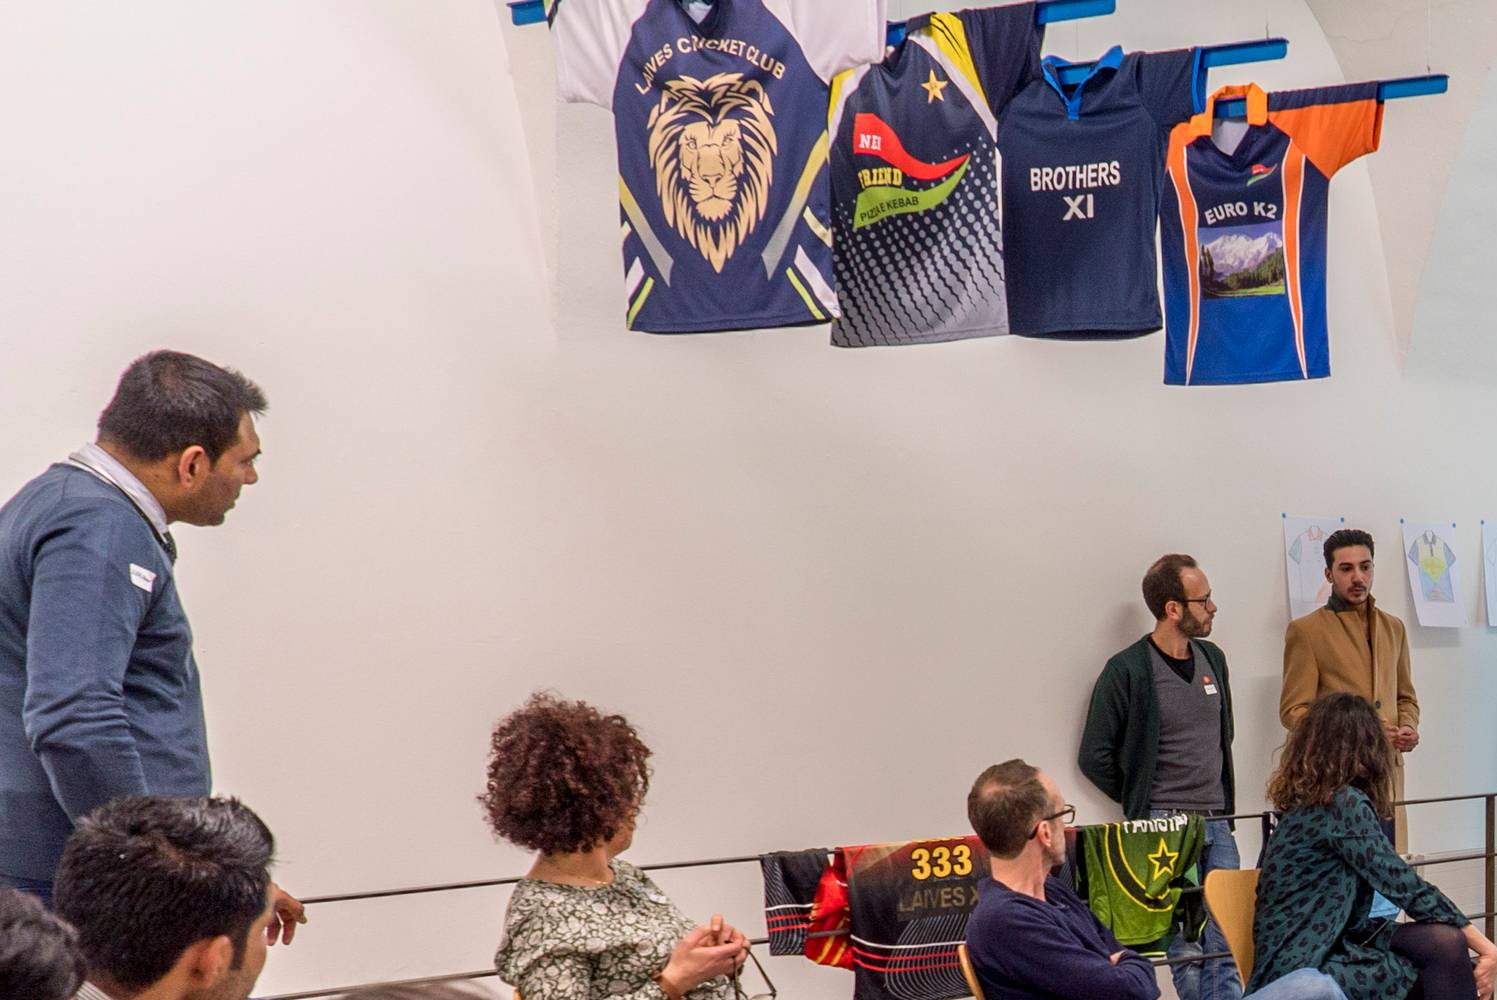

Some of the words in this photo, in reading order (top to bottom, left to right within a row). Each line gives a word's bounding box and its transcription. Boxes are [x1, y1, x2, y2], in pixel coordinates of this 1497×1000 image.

[635, 43, 673, 95] LAIVES
[676, 34, 746, 56] CRICKET
[746, 46, 786, 80] CLUB
[1030, 161, 1121, 192] BROTHERS
[886, 196, 919, 210] KEBAB
[1062, 193, 1095, 220] XI
[1204, 201, 1248, 225] EURO
[1253, 201, 1278, 219] K2
[911, 844, 973, 880] 333
[899, 886, 966, 912] LAIVES
